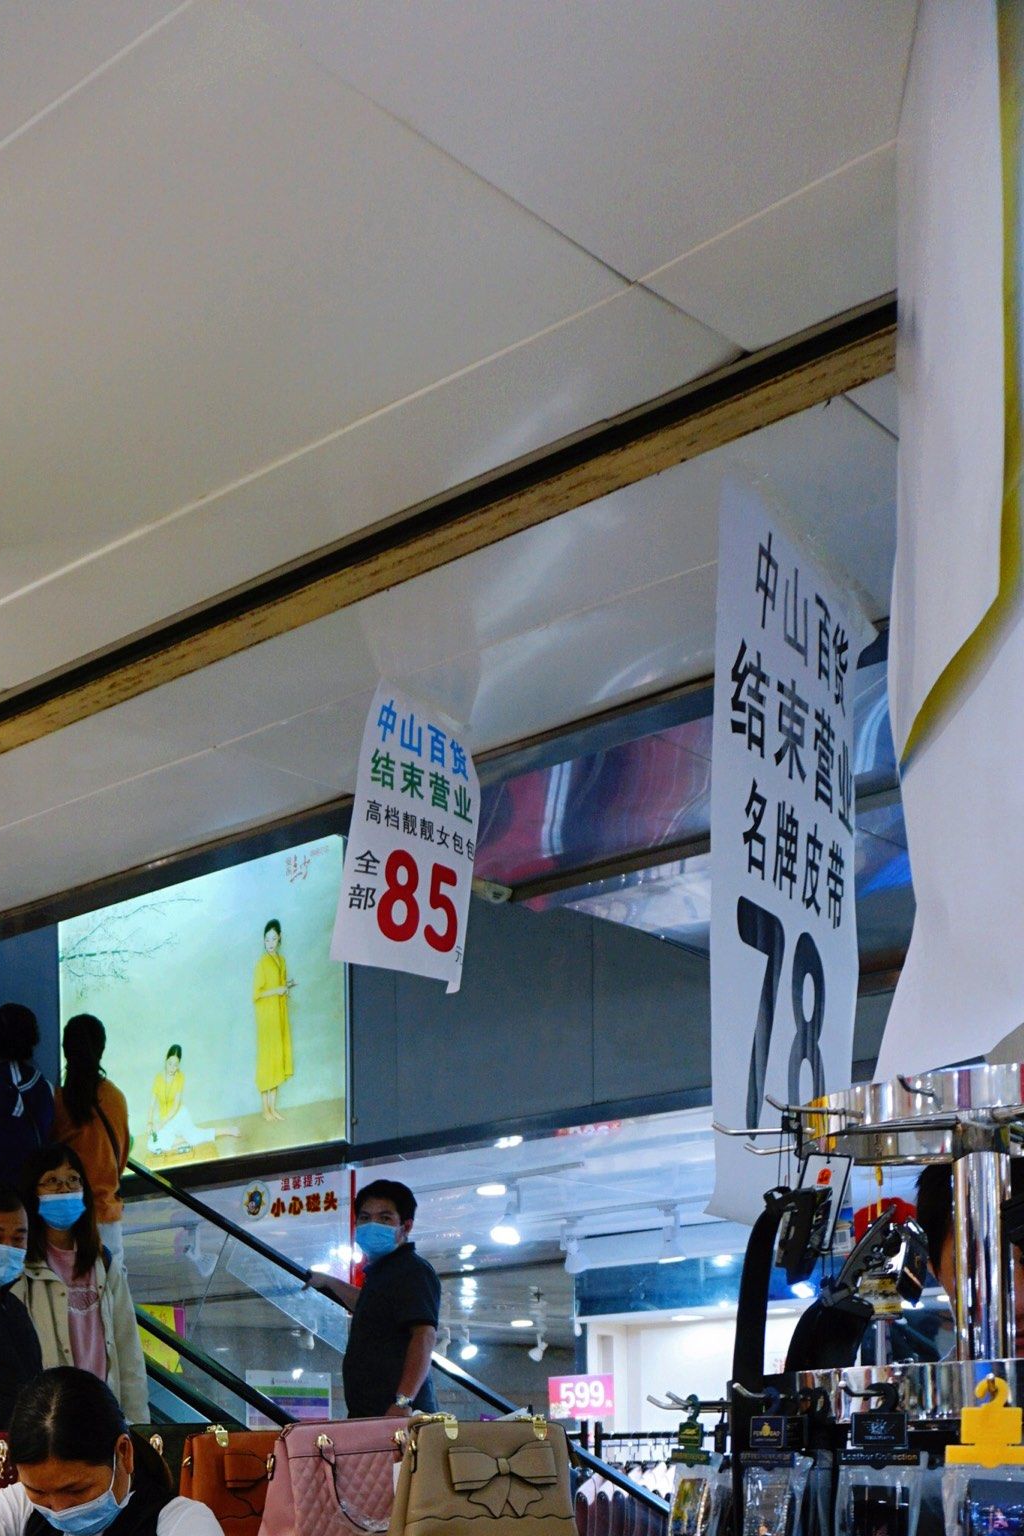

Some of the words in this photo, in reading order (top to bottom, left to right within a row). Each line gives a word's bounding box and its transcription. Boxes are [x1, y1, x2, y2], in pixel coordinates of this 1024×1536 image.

[755, 531, 850, 716] 中山百货
[376, 698, 470, 782] 中山百货
[730, 637, 855, 838] 结束营业
[370, 748, 474, 826] 结束营业
[365, 799, 476, 863] 高档靓靓女包包
[742, 777, 846, 931] 名牌皮带
[347, 849, 381, 911] 全部
[376, 848, 458, 953] 85
[737, 895, 826, 1142] 78
[270, 1190, 339, 1218] 小心碰头
[280, 1173, 325, 1192] 温馨提示
[559, 1380, 605, 1409] 599
